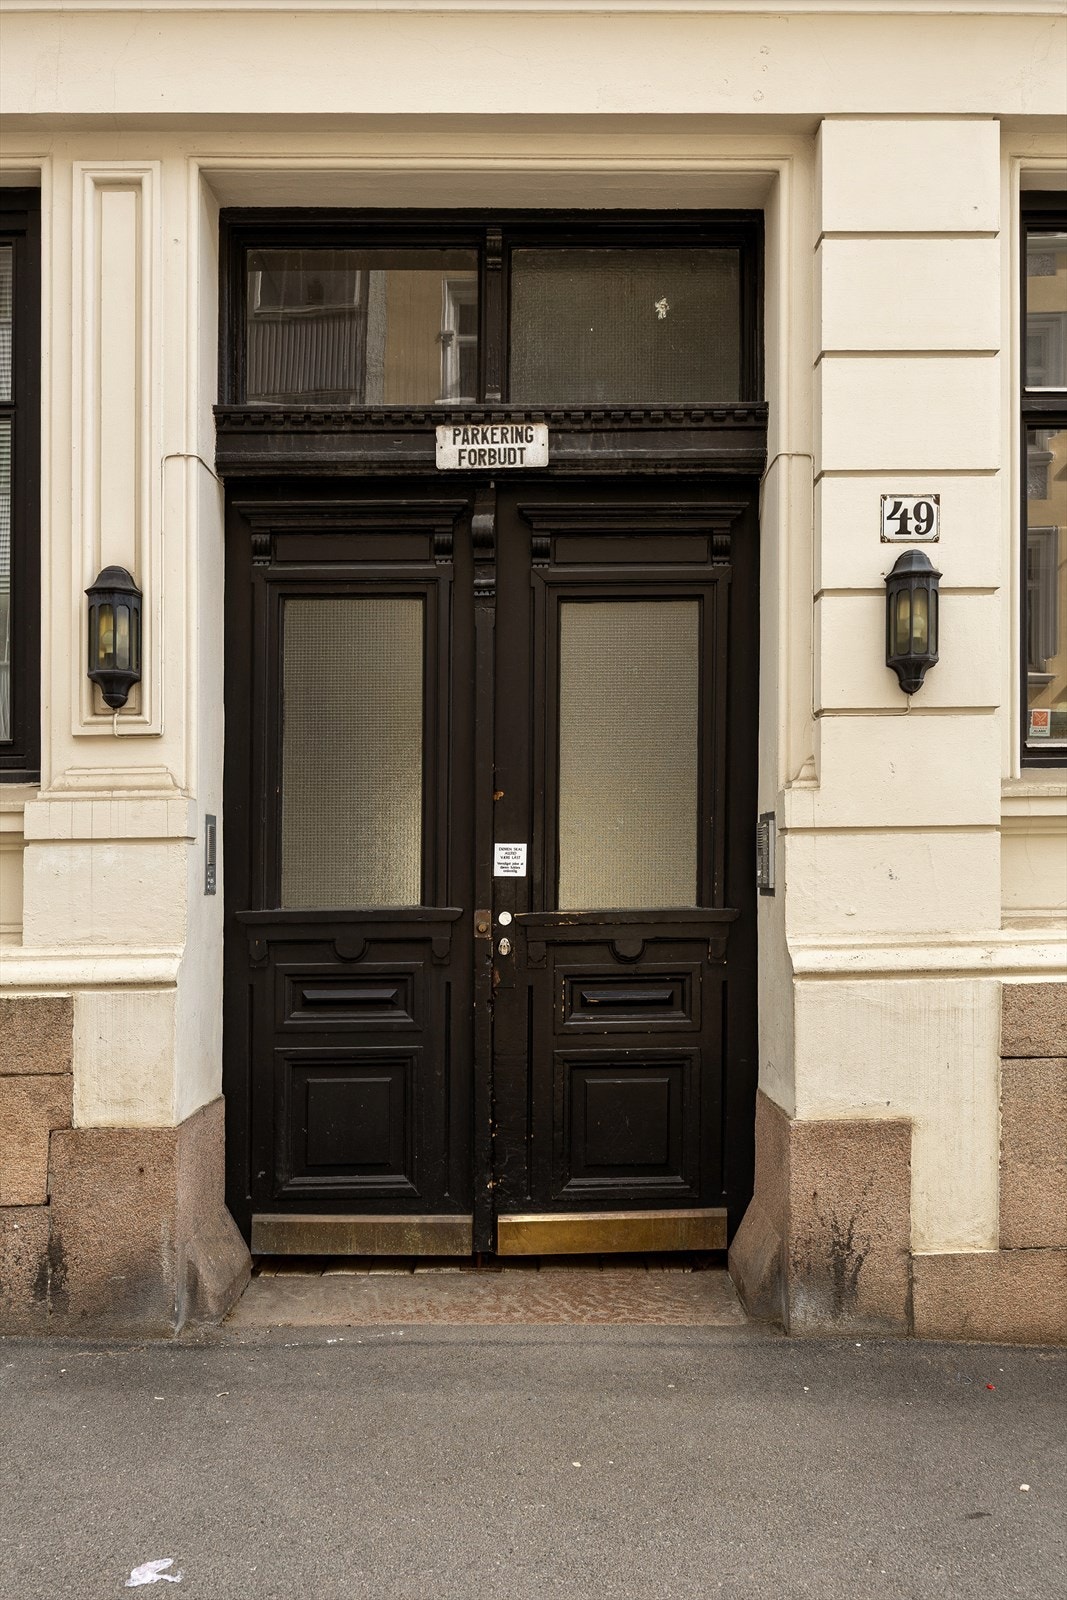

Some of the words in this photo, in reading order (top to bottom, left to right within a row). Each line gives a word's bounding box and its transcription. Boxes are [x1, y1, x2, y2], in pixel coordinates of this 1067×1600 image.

[452, 426, 534, 445] PARKERING
[458, 447, 527, 466] FORBUDT
[886, 501, 934, 535] 49
